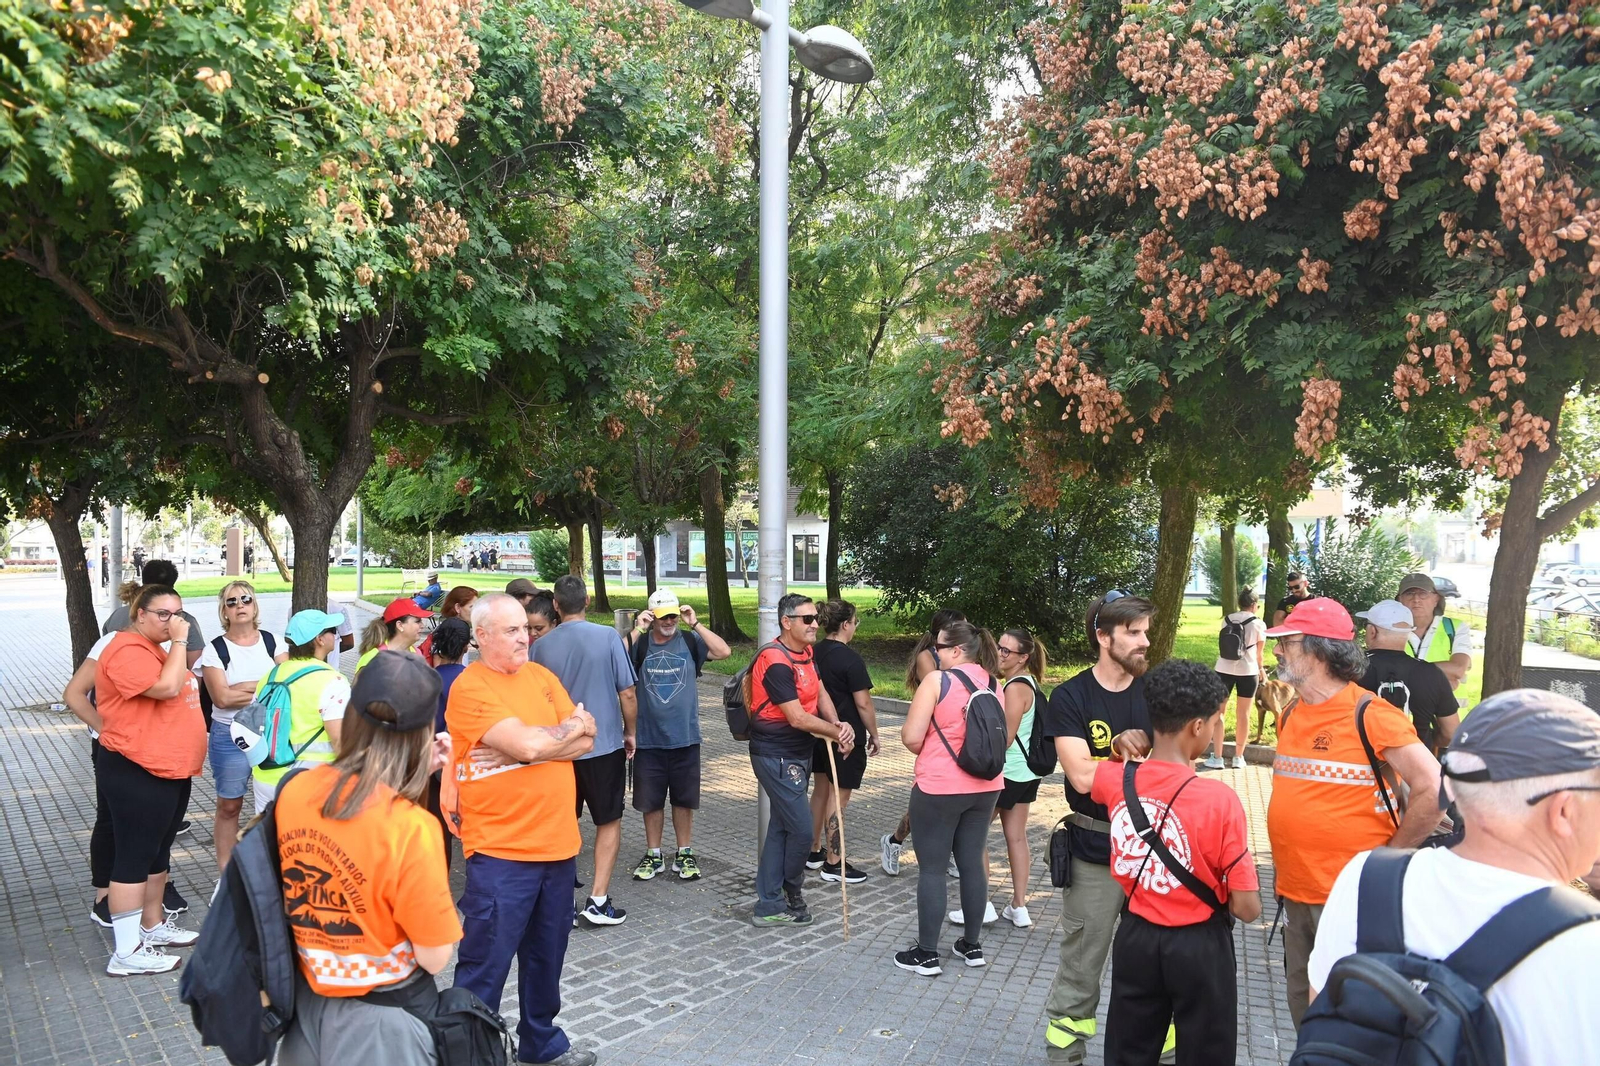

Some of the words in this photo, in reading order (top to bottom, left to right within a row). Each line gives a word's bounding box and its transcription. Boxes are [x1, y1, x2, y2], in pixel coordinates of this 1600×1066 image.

[283, 843, 303, 858] LOCAL
[305, 843, 315, 854] DE
[316, 846, 342, 878] PRONTO
[339, 878, 366, 914] AUXILIO
[309, 828, 318, 840] DE
[319, 832, 366, 885] VOLUNTARIOS
